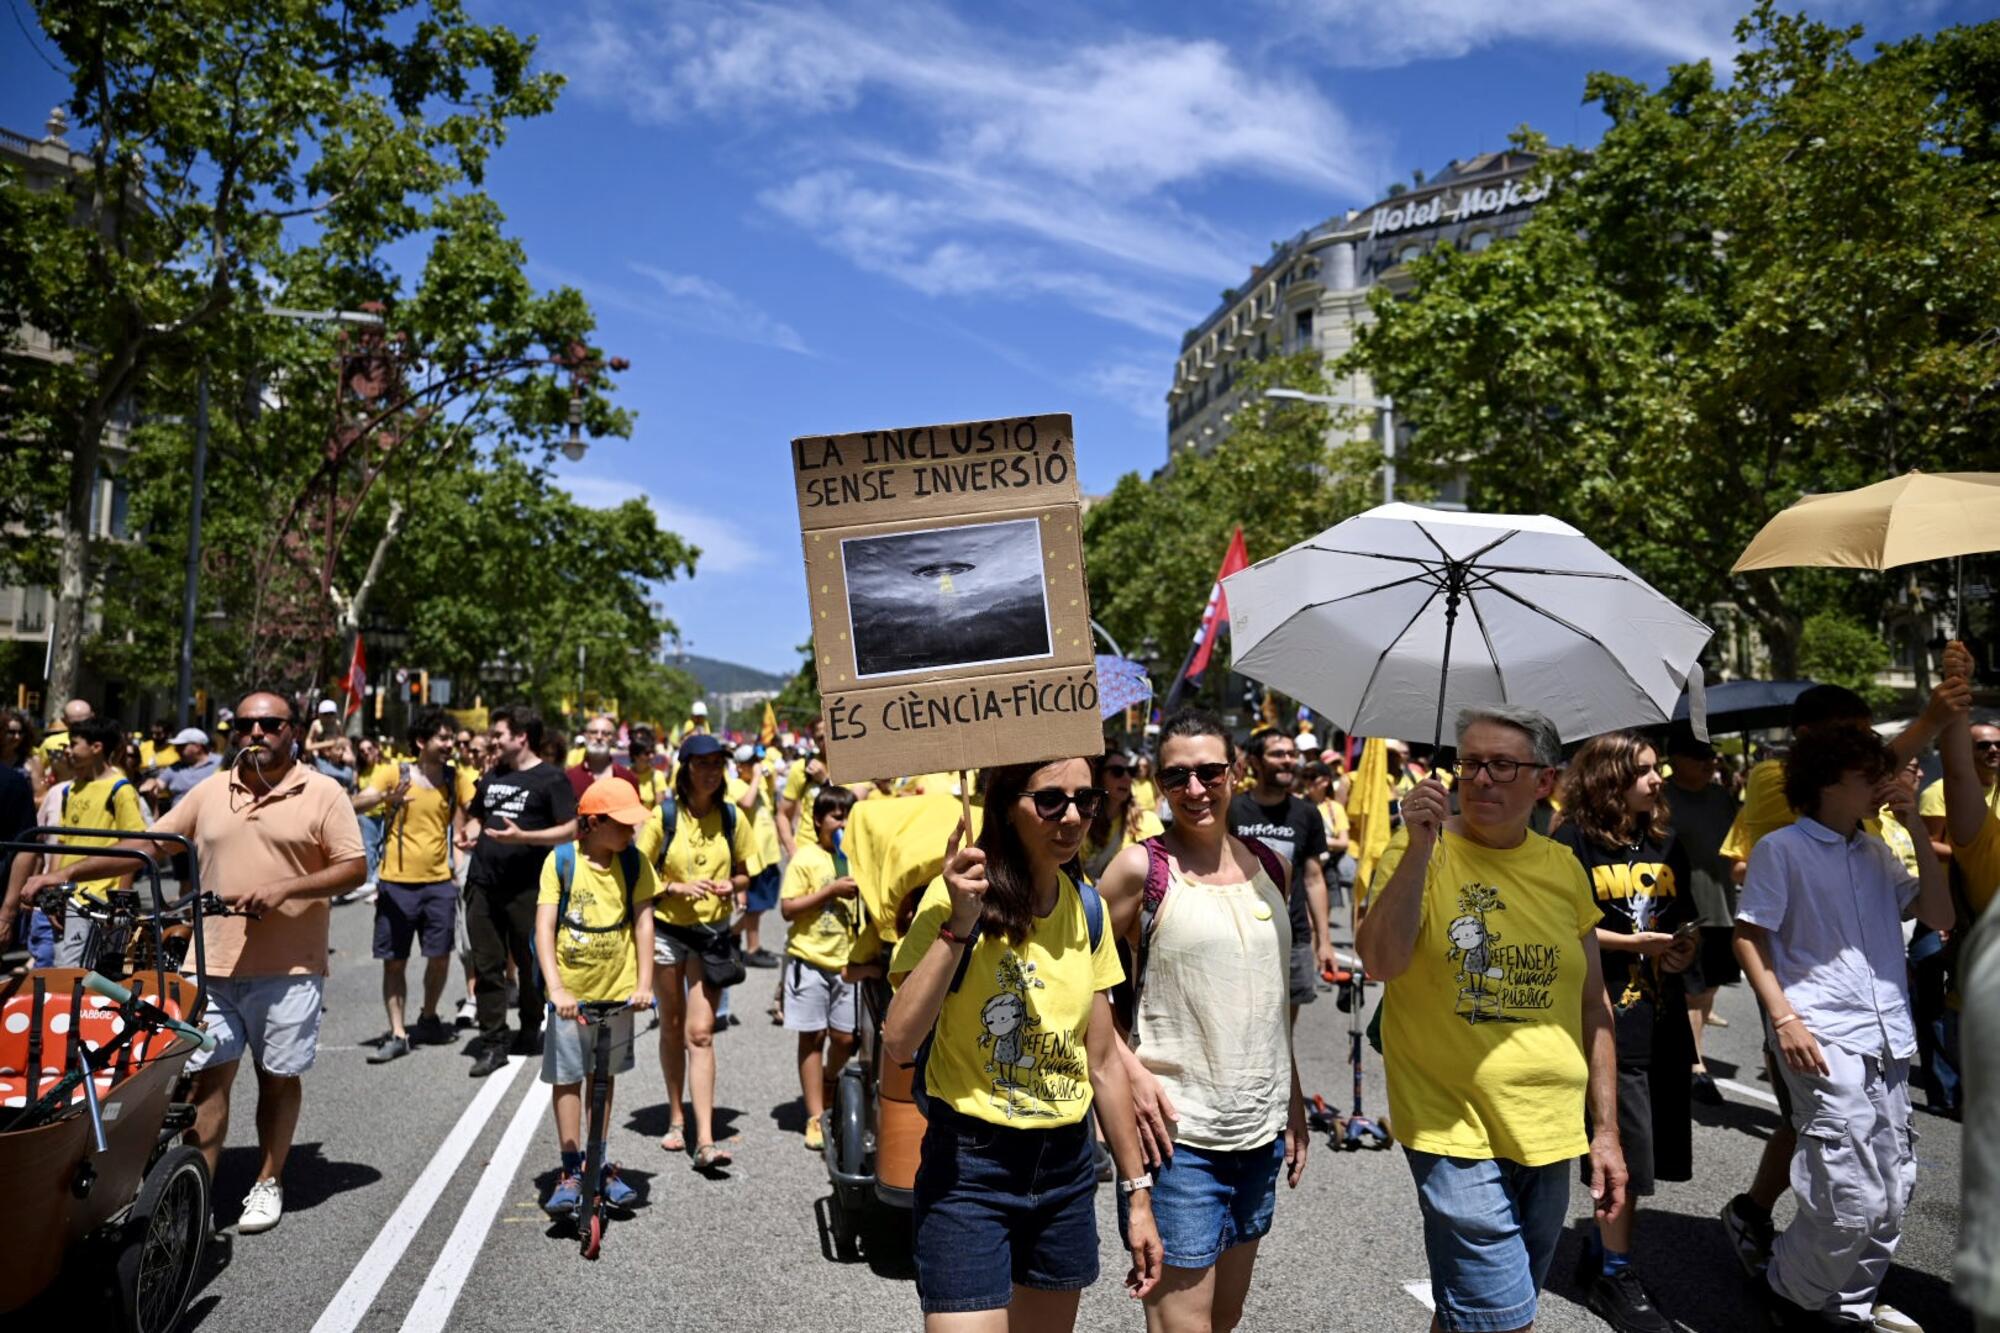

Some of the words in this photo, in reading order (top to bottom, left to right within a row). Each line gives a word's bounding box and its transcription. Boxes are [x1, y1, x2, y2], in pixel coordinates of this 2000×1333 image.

[1368, 196, 1442, 240] Hotel
[798, 433, 844, 471] LA
[862, 417, 1038, 464] INCLUSIÓ
[806, 469, 897, 508] SENSE
[914, 440, 1068, 496] INVERSIÓ
[829, 697, 867, 741] ÉS
[882, 670, 1098, 731] CIÈNCIA-FICCIÓ
[1490, 944, 1555, 970] DEFENSEM
